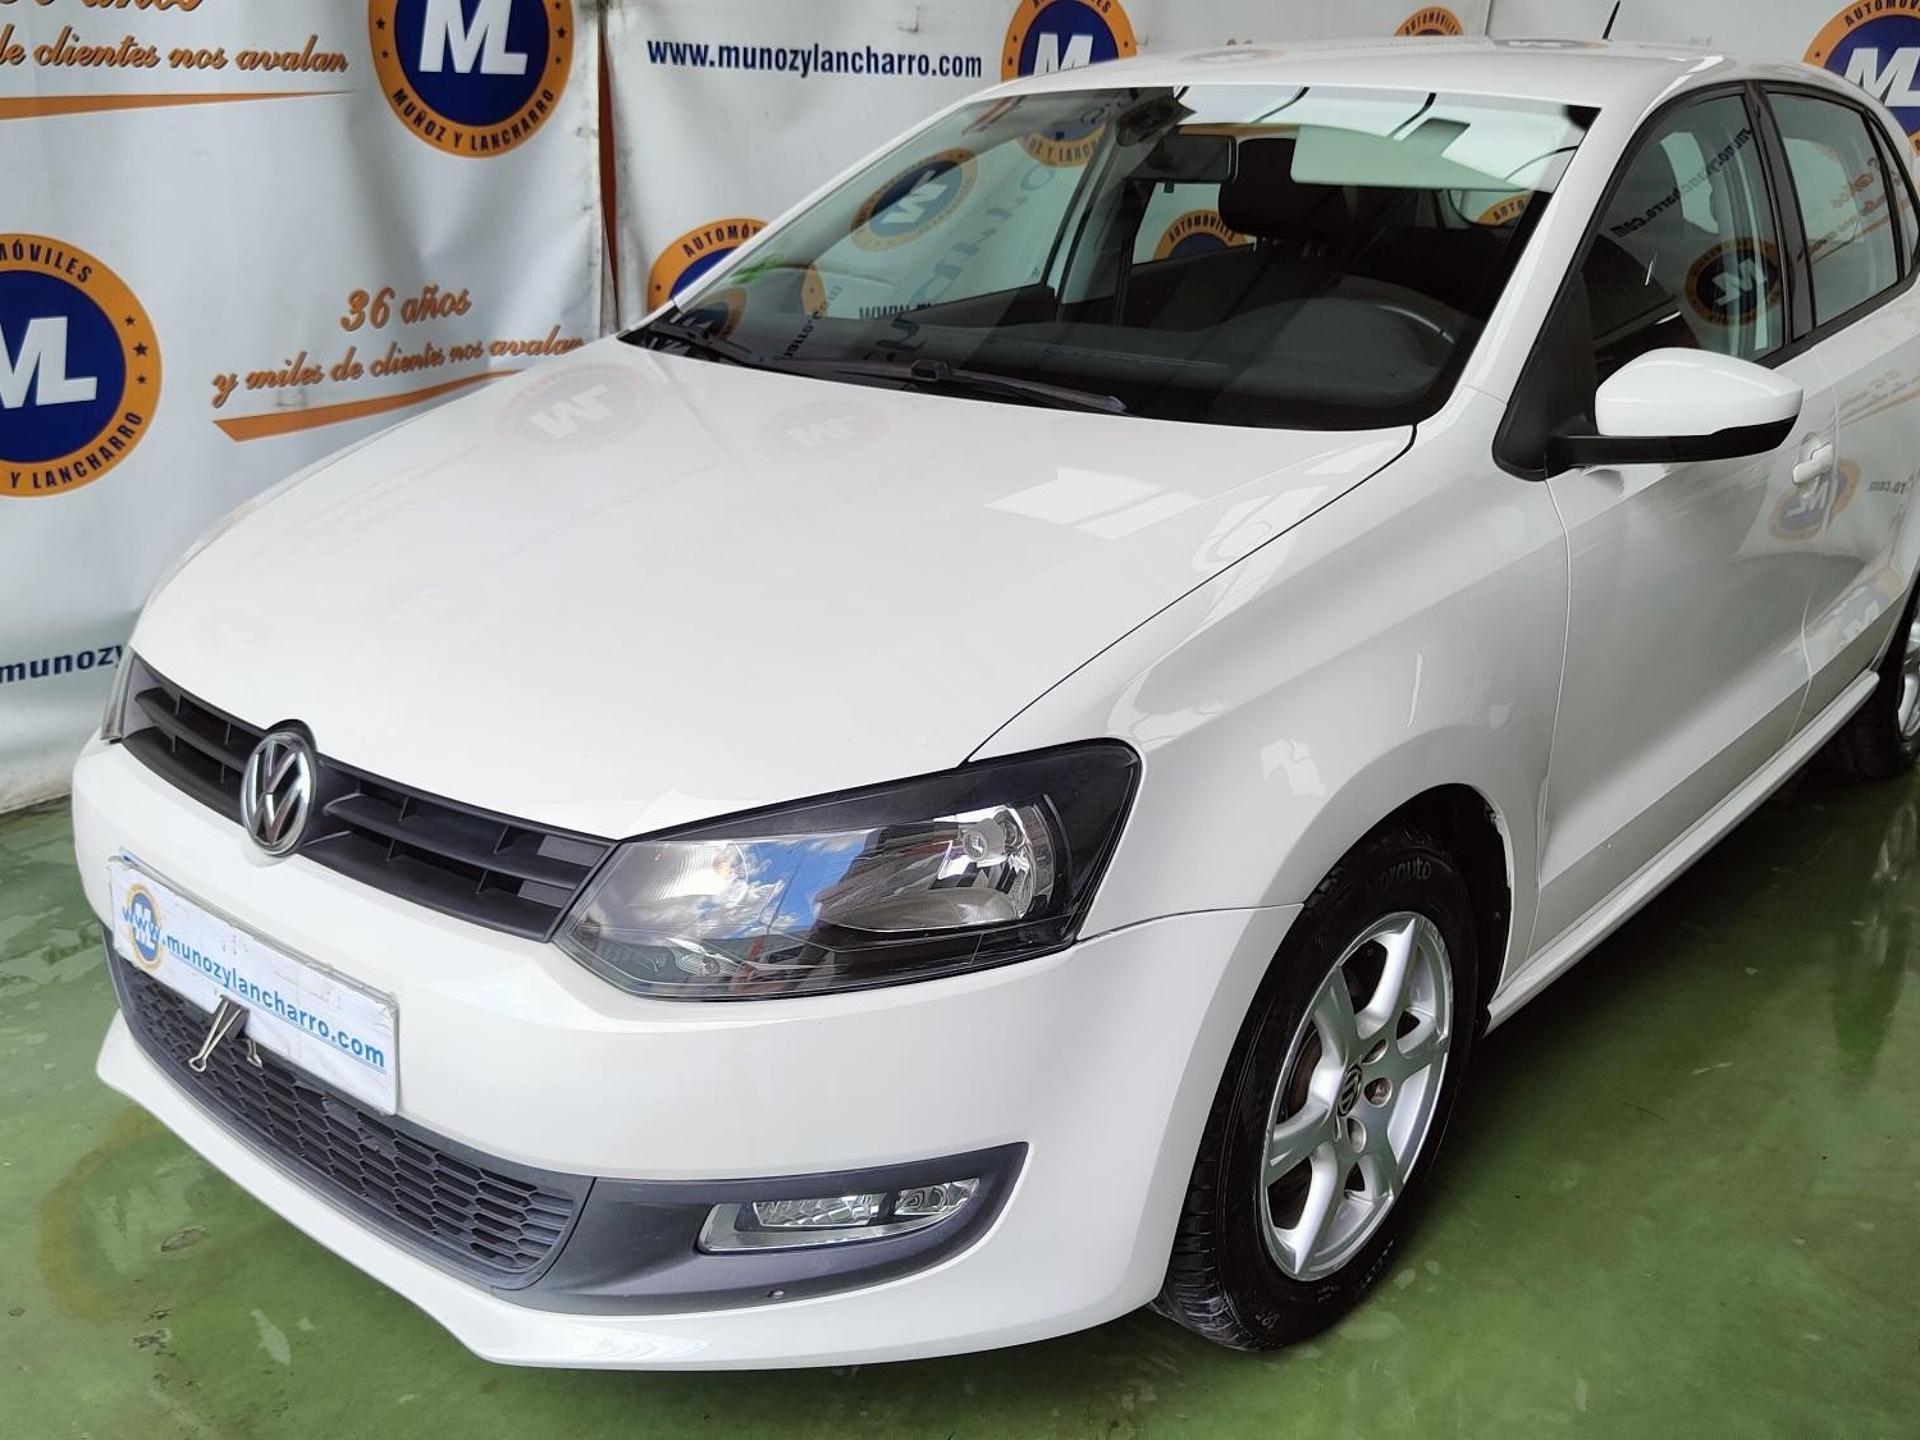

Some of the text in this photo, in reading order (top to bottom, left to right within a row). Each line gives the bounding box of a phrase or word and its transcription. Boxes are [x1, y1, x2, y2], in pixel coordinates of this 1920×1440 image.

[33, 25, 161, 69] clientes
[168, 47, 228, 70] nos
[235, 34, 348, 73] avalan
[419, 0, 528, 75] ML
[647, 40, 982, 79] www.munozylancharro.com
[393, 88, 555, 151] MUÑOZ Y LANCHARRO
[340, 284, 473, 332] 36 años
[212, 325, 584, 408] y miles de clientes nos avalan
[10, 412, 143, 489] Y LANCHARRO
[122, 905, 386, 1068] www.munozylancharro.com
